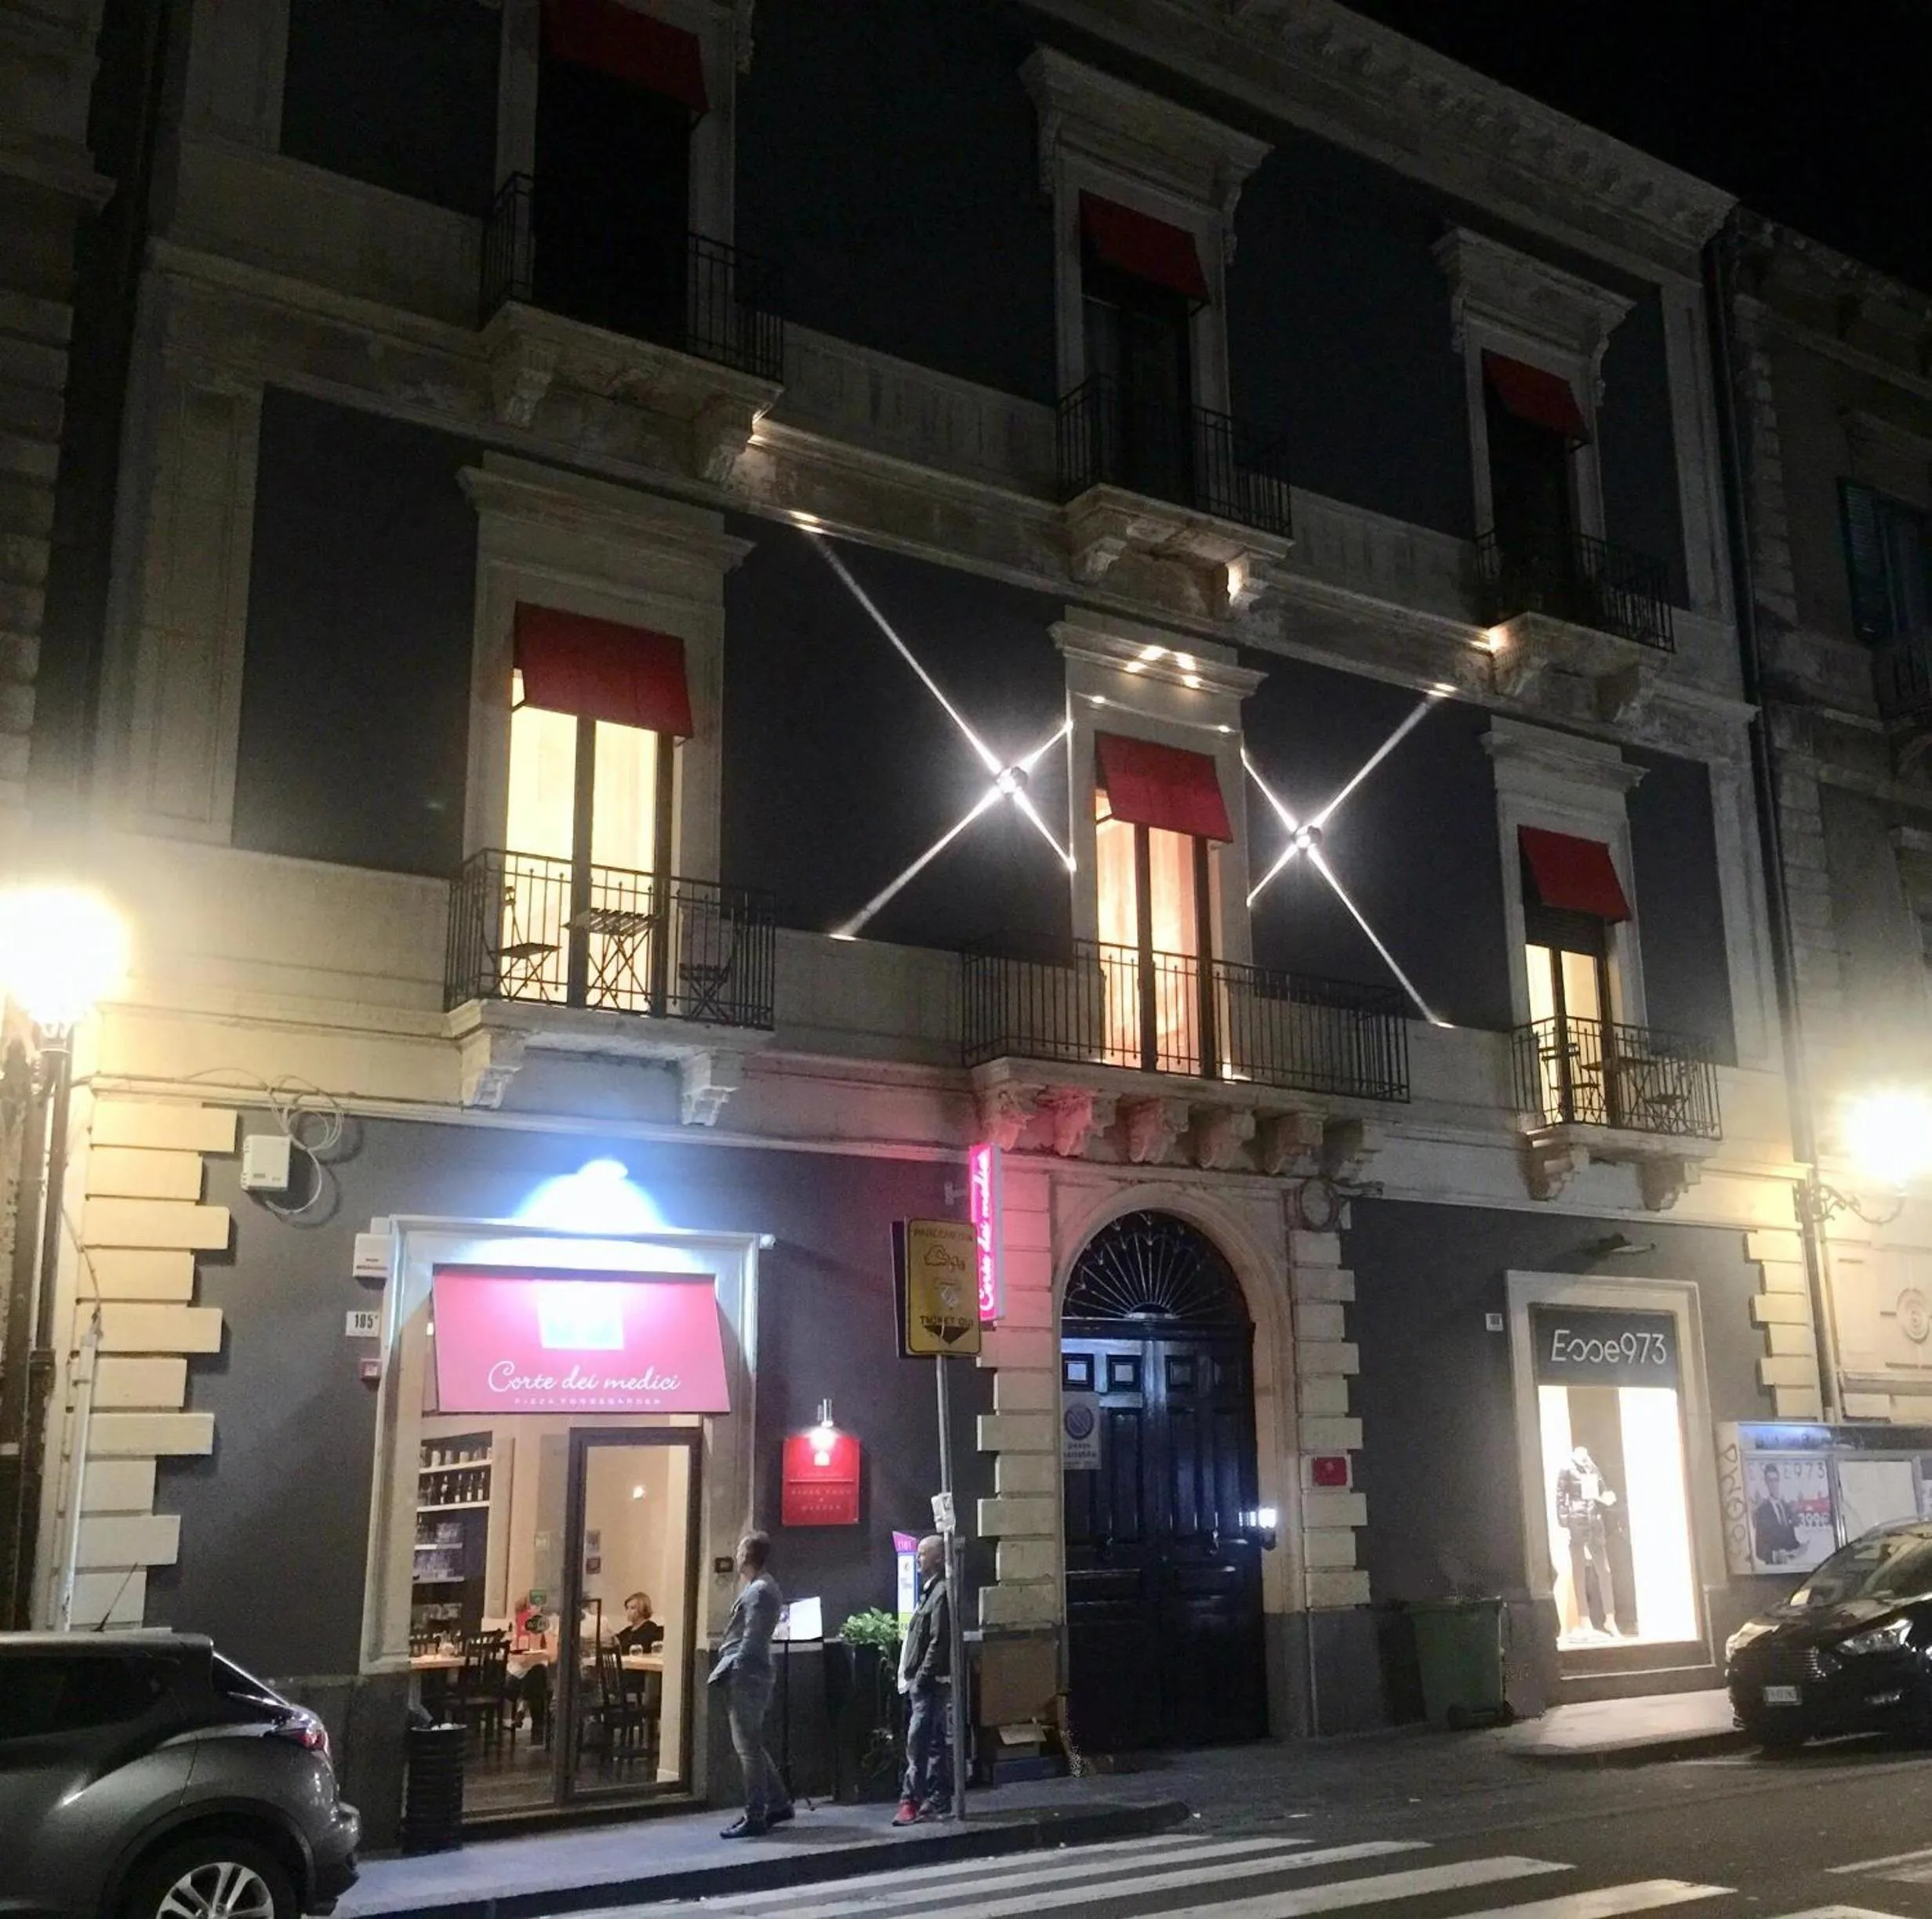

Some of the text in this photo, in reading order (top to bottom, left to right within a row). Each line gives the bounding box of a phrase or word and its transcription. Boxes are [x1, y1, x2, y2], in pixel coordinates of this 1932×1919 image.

[1551, 1330, 1667, 1365] Esse973
[488, 1360, 681, 1392] Corte dei medici
